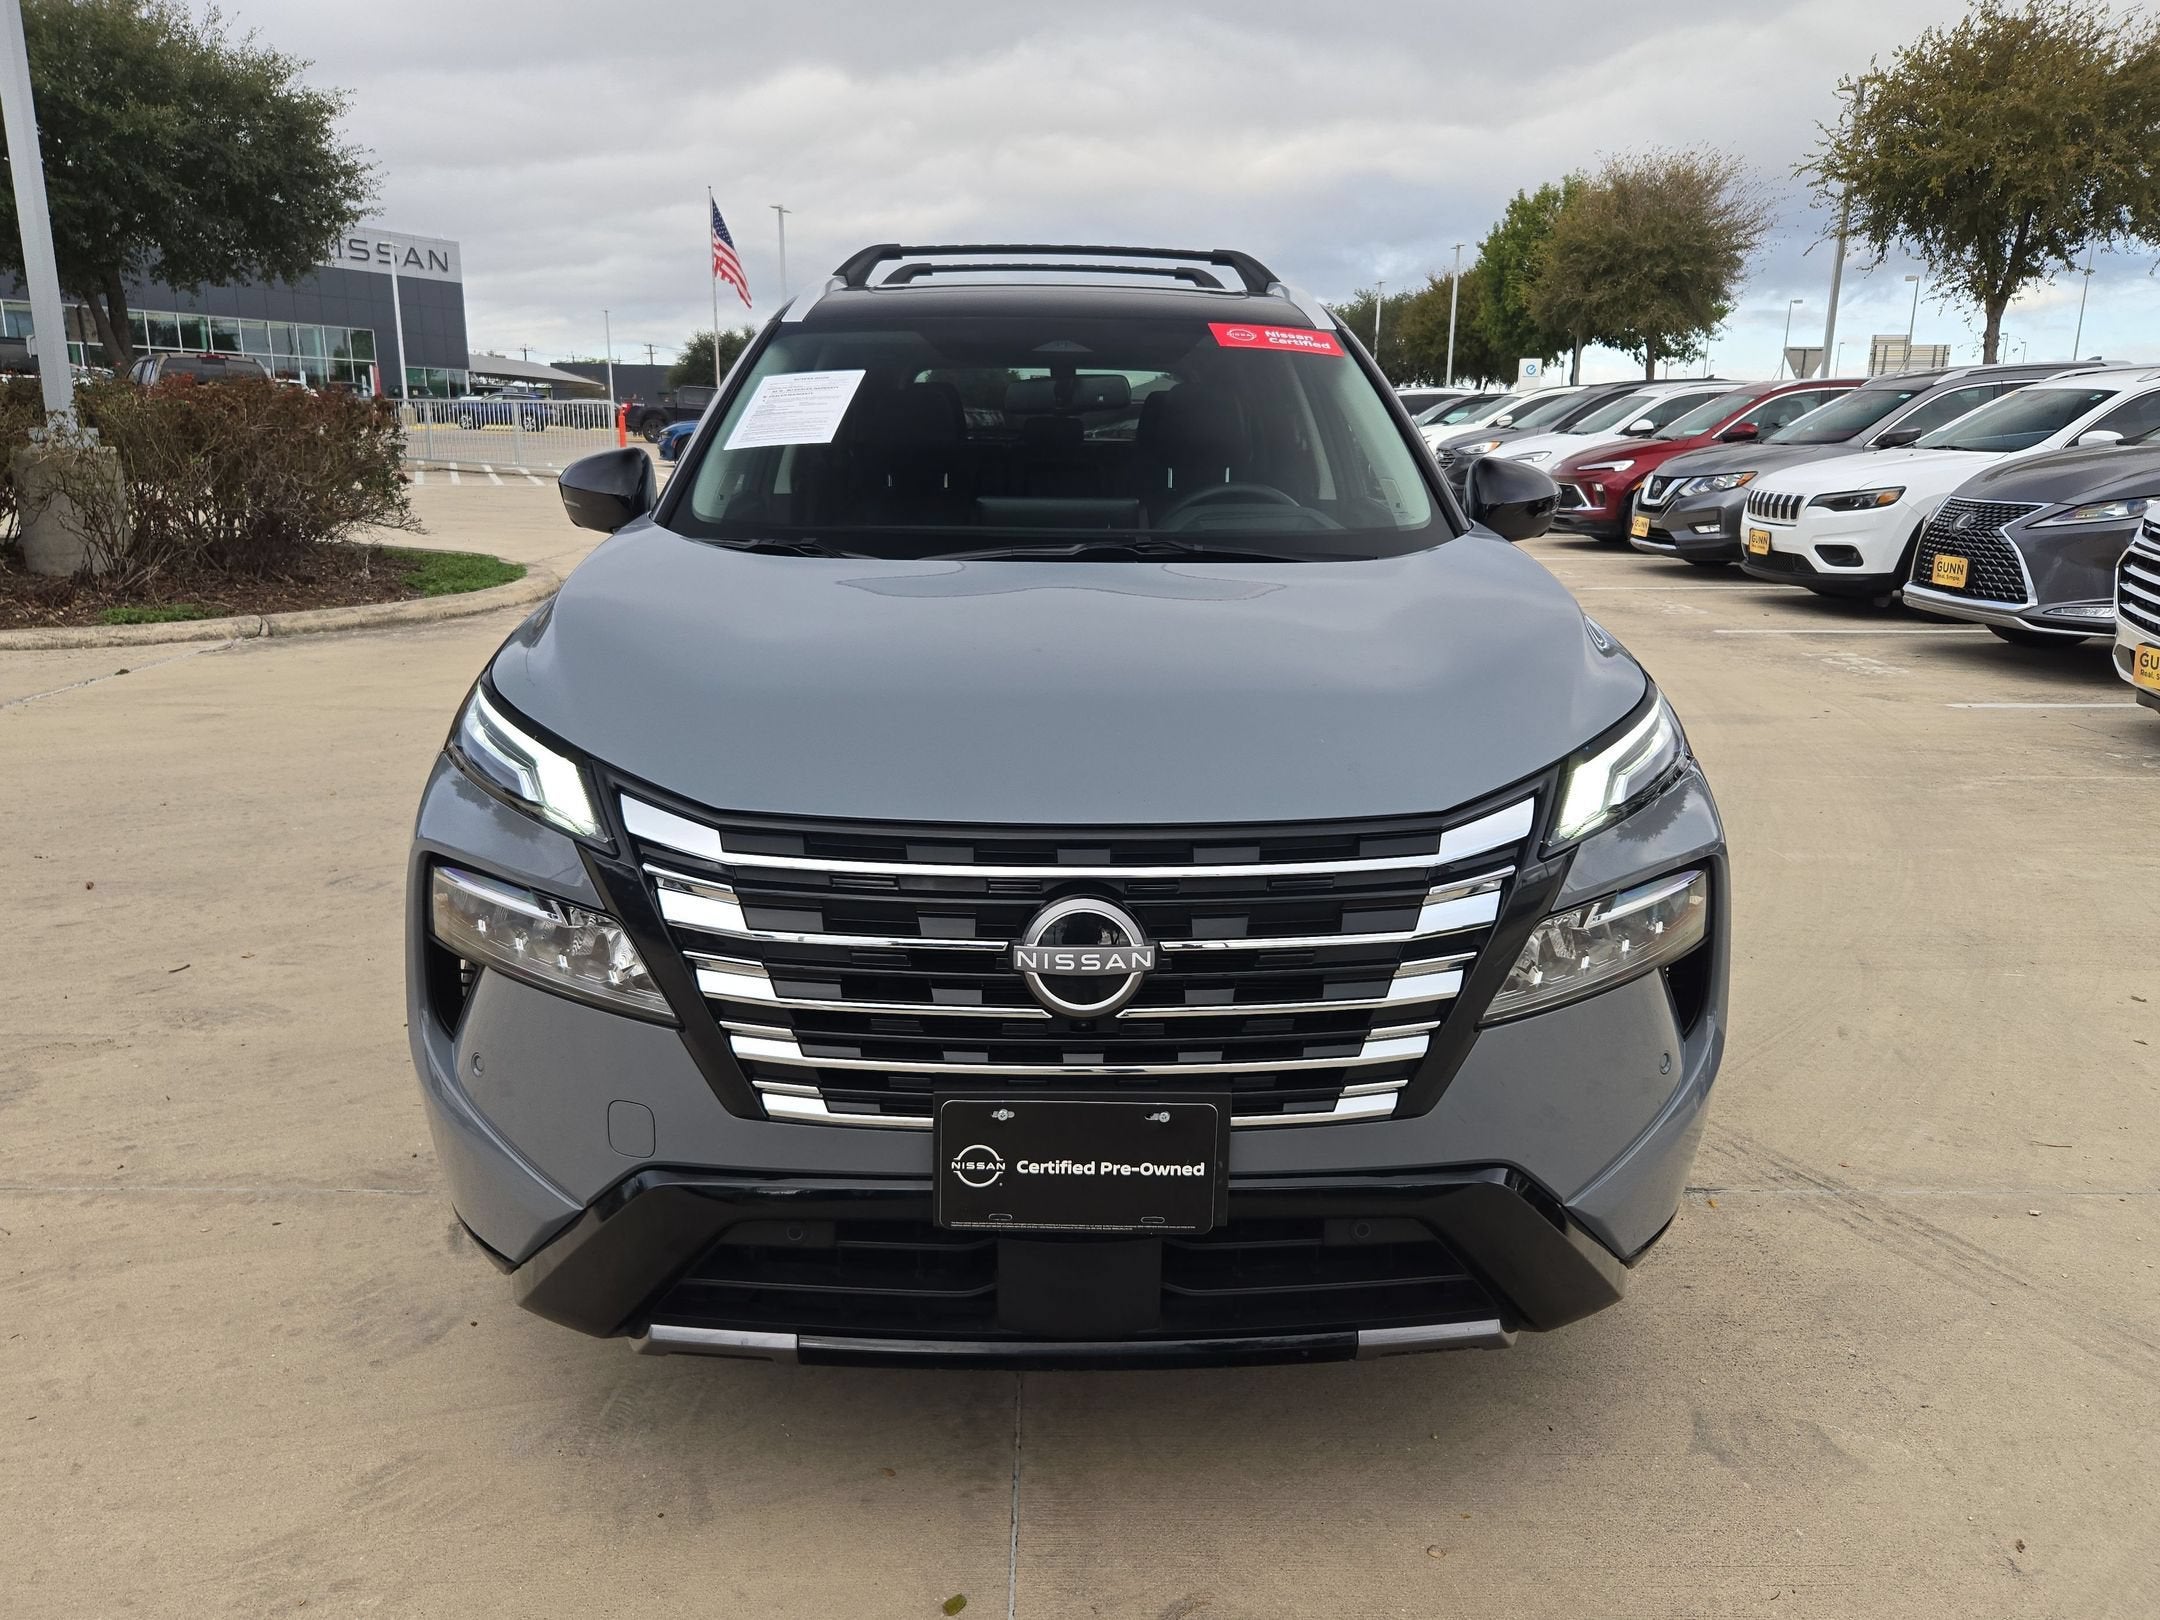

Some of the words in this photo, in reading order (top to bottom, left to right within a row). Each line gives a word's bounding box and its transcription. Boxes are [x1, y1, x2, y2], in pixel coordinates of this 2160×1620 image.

[325, 237, 449, 272] ISSAN
[1264, 330, 1315, 341] Nissan
[1268, 338, 1331, 349] Certified
[1751, 535, 1768, 545] GUNN
[1936, 561, 1965, 576] GUNN
[1016, 951, 1152, 970] NISSAN
[951, 1161, 1006, 1171] NISSAN
[1016, 1160, 1096, 1175] Certified
[1100, 1161, 1205, 1176] Pre-Owned
